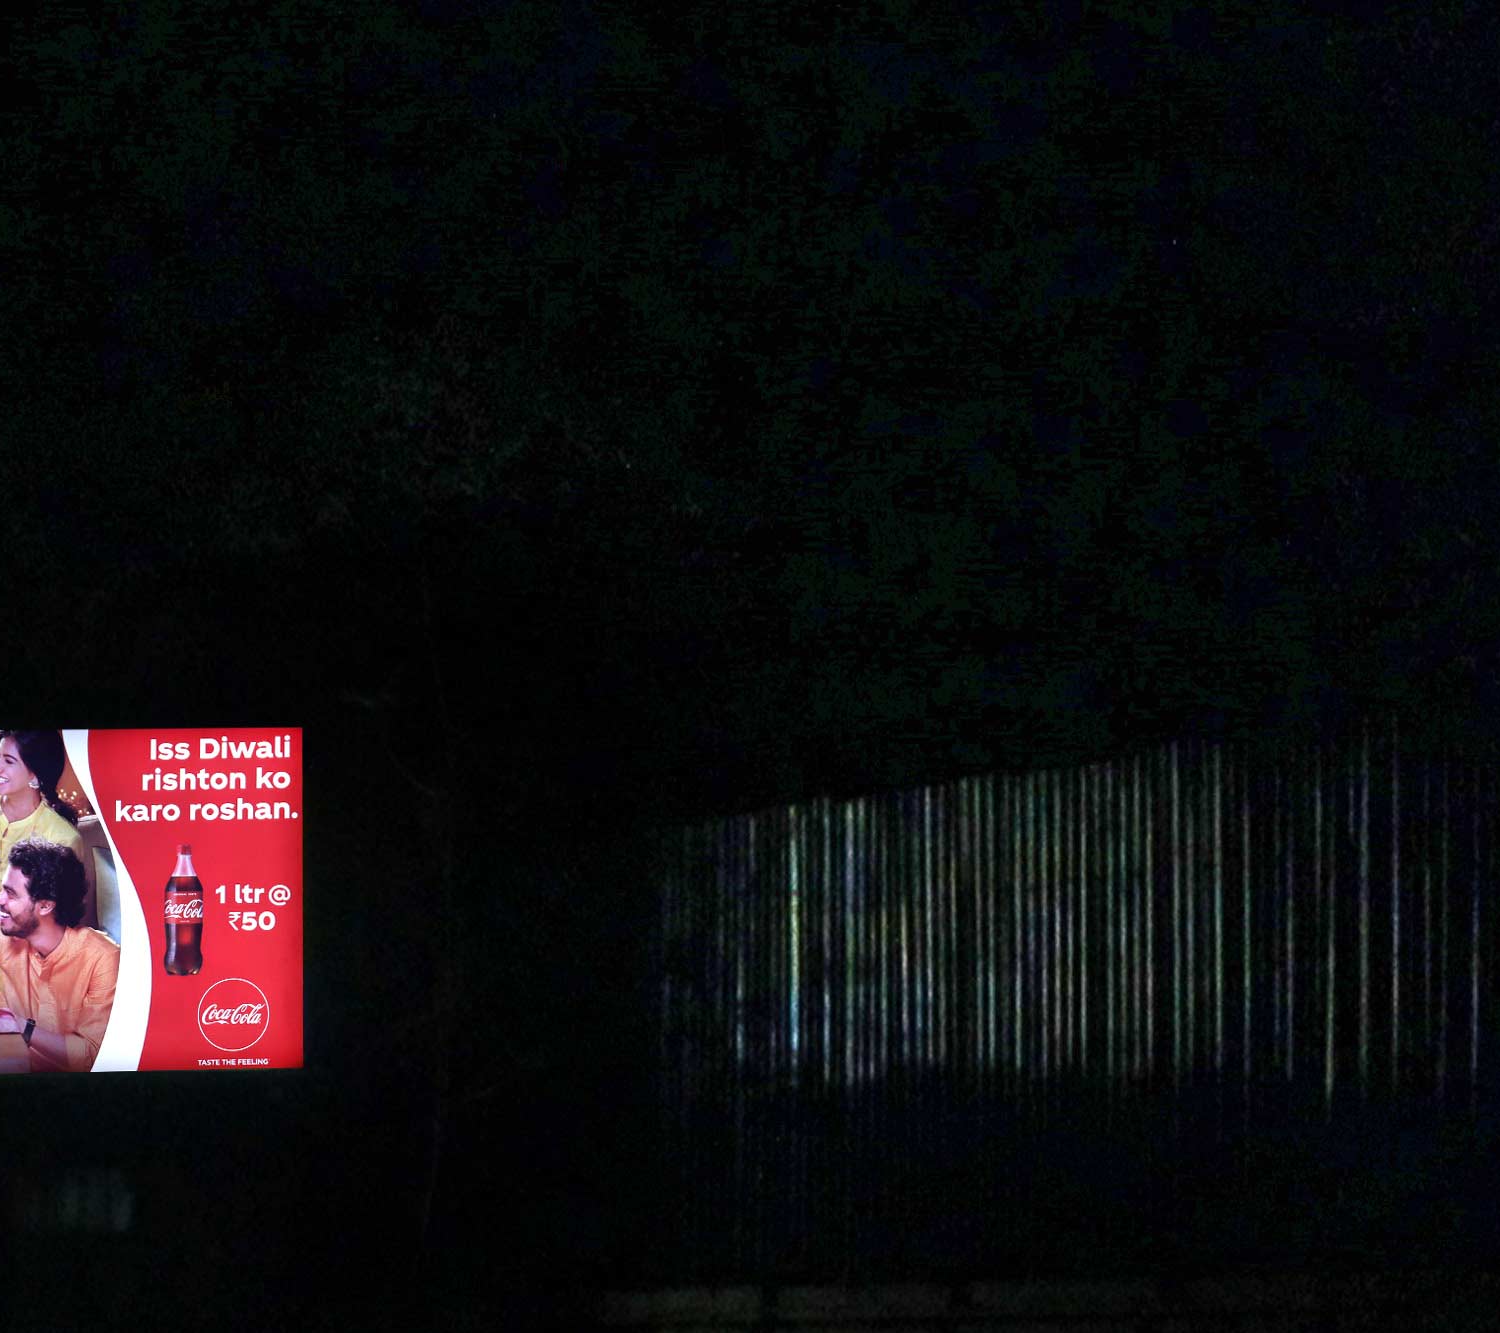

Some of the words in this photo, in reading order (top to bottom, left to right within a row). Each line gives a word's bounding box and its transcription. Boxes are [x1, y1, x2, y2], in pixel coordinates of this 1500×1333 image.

[150, 738, 191, 761] Iss
[199, 735, 291, 760] Diwali
[141, 768, 247, 792] rishton
[256, 767, 291, 789] ko
[115, 799, 181, 822] karo
[189, 797, 299, 821] roshan.
[215, 885, 226, 904] 1
[234, 883, 265, 904] ltr
[268, 884, 291, 906] @
[164, 899, 203, 918] Coca-Col
[228, 911, 276, 931] ₹50
[201, 1003, 265, 1025] Coca-Cola
[221, 1058, 237, 1066] THE
[237, 1058, 269, 1066] FEELING
